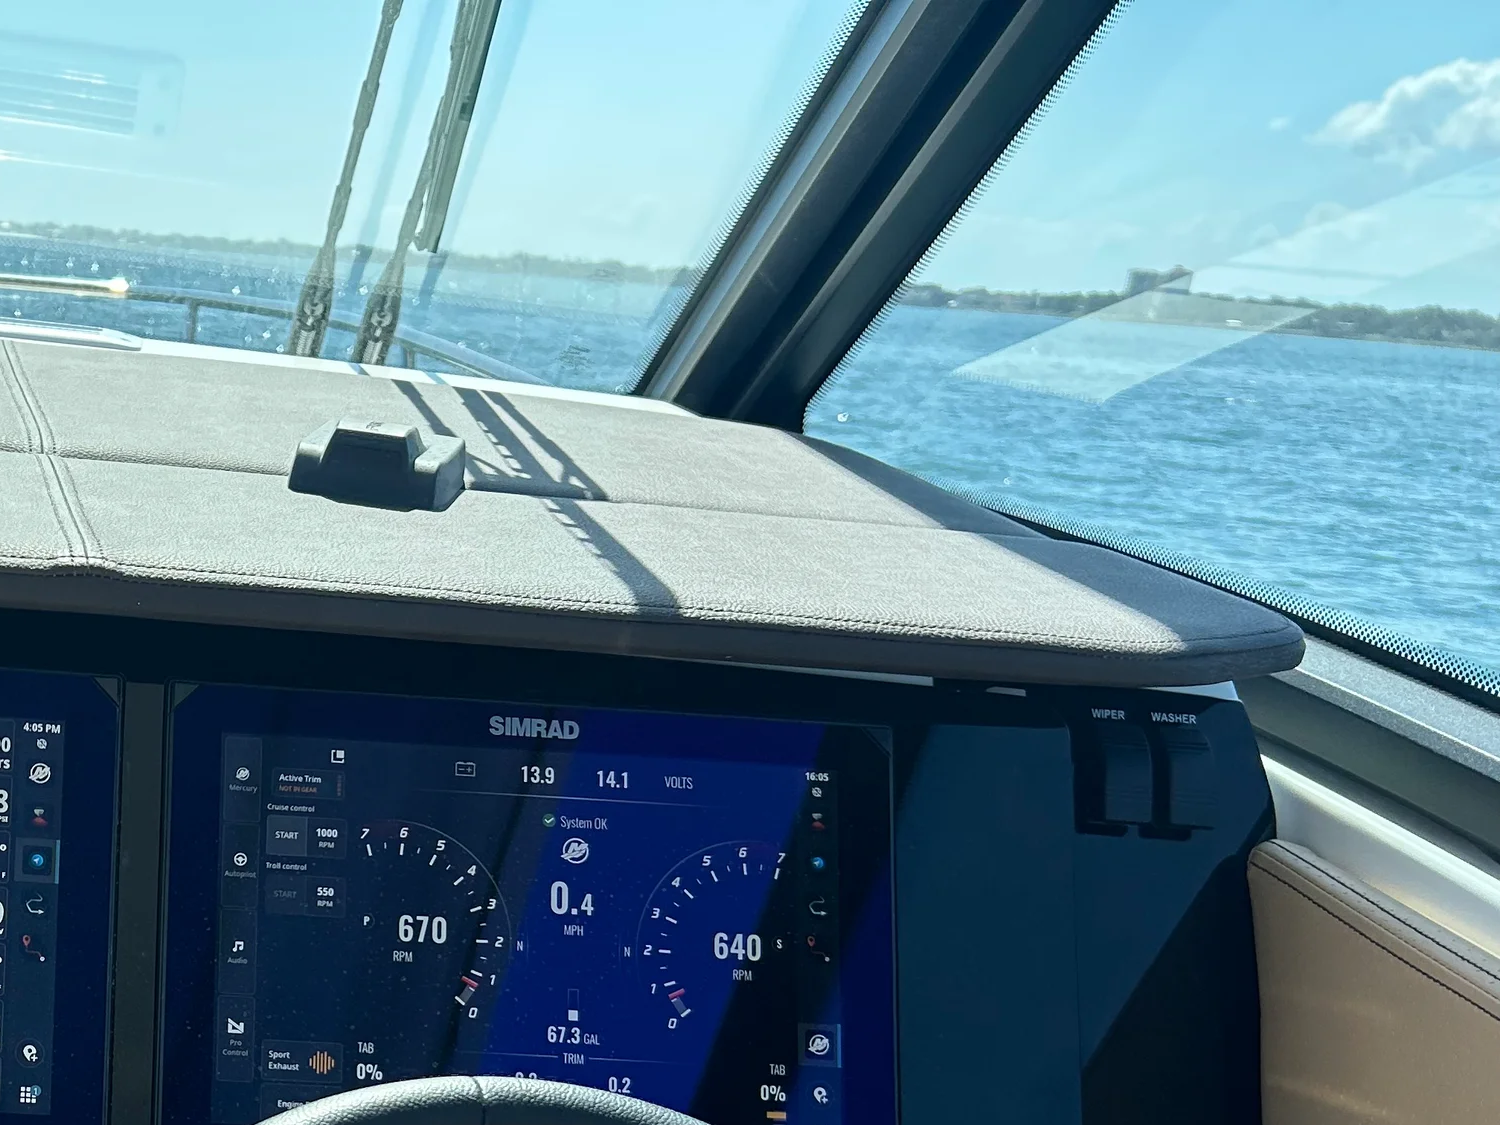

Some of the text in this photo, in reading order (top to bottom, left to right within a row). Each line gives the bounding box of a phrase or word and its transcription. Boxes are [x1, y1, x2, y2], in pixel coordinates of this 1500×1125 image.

[1091, 708, 1126, 720] WIPER
[1150, 711, 1197, 725] WASHER
[23, 722, 61, 734] 4:05 PM
[489, 716, 580, 740] SIMRAD
[279, 774, 322, 784] Active Trim
[521, 765, 693, 790] 13.9 14.1 VOLTS
[805, 772, 829, 782] 16:05
[267, 803, 315, 813] Cruise control
[560, 815, 608, 830] System OK
[275, 831, 299, 840] START
[316, 828, 338, 838] 1000
[318, 841, 335, 849] RPM
[266, 862, 307, 871] Troll control
[317, 887, 335, 897] 550
[550, 880, 594, 916] 0.4
[317, 900, 333, 908] RPM
[399, 914, 447, 944] 670
[564, 925, 584, 936] MPH
[713, 932, 762, 961] 640
[393, 951, 413, 963] RPM
[732, 969, 752, 981] RPM
[547, 1026, 600, 1045] 67.3 GAL
[357, 1042, 374, 1053] TAB
[268, 1050, 290, 1060] Sport
[563, 1052, 584, 1064] TRIM
[268, 1062, 299, 1071] Exhaust
[356, 1063, 383, 1081] 0%
[769, 1064, 786, 1075] TAB
[608, 1077, 631, 1093] 0.2
[760, 1084, 786, 1101] 0%
